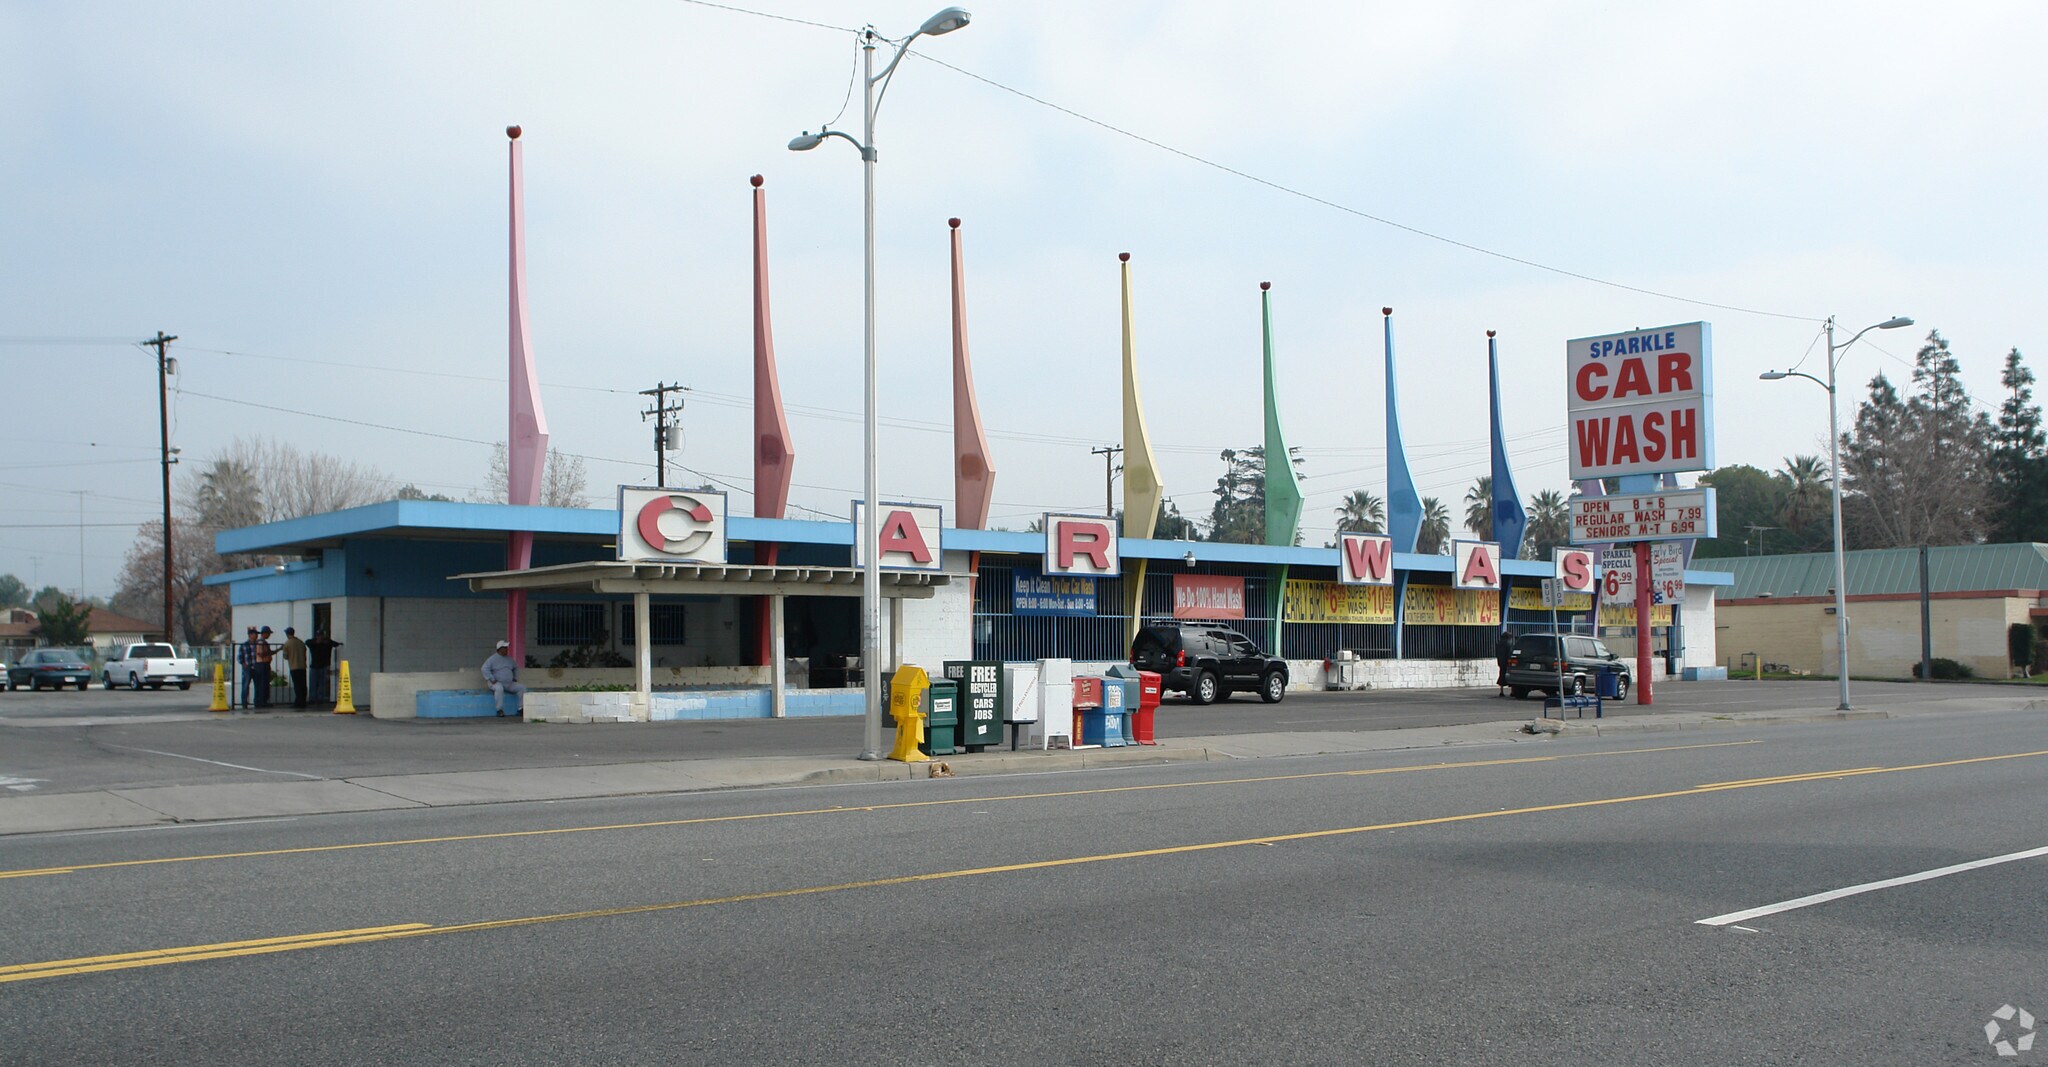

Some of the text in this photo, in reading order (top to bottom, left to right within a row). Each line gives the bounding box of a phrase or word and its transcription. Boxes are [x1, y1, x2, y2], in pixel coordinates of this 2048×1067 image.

[1590, 332, 1675, 358] SPARKLE
[1576, 352, 1693, 402] CAR
[1576, 408, 1697, 468] WASH
[1583, 502, 1610, 513] OPEN
[1633, 499, 1640, 510] 8
[1658, 497, 1665, 509] 6
[1576, 507, 1701, 527] REGULAR WASH 7.99
[1586, 525, 1630, 538] SENIORS
[1671, 521, 1695, 533] 6.99
[637, 495, 714, 555] C
[1057, 521, 1111, 569] R
[1344, 538, 1392, 579] W
[1462, 547, 1497, 584] A
[1563, 552, 1590, 589] S
[1602, 549, 1632, 559] SPARKEL
[1653, 555, 1678, 565] Special
[1602, 559, 1632, 569] SPECIAL
[1015, 576, 1030, 597] Keep
[1035, 576, 1051, 593] Clean
[1051, 577, 1060, 598] Try
[1060, 577, 1070, 595] Our
[1071, 577, 1080, 595] Car
[1080, 578, 1095, 596] Wash
[1346, 584, 1367, 600] SUPER
[1544, 583, 1552, 603] BUS
[1015, 597, 1028, 609] OPEN
[1176, 586, 1243, 609] We Do 100% Hand Wash
[1286, 581, 1326, 621] EARLY BIRD
[1406, 587, 1435, 611] SENIORS
[1347, 600, 1368, 615] WASH
[948, 665, 964, 678] FREE
[971, 666, 997, 682] FREE
[970, 682, 997, 694] RECYCLER
[973, 698, 994, 709] CARS
[973, 709, 993, 720] JOBS
